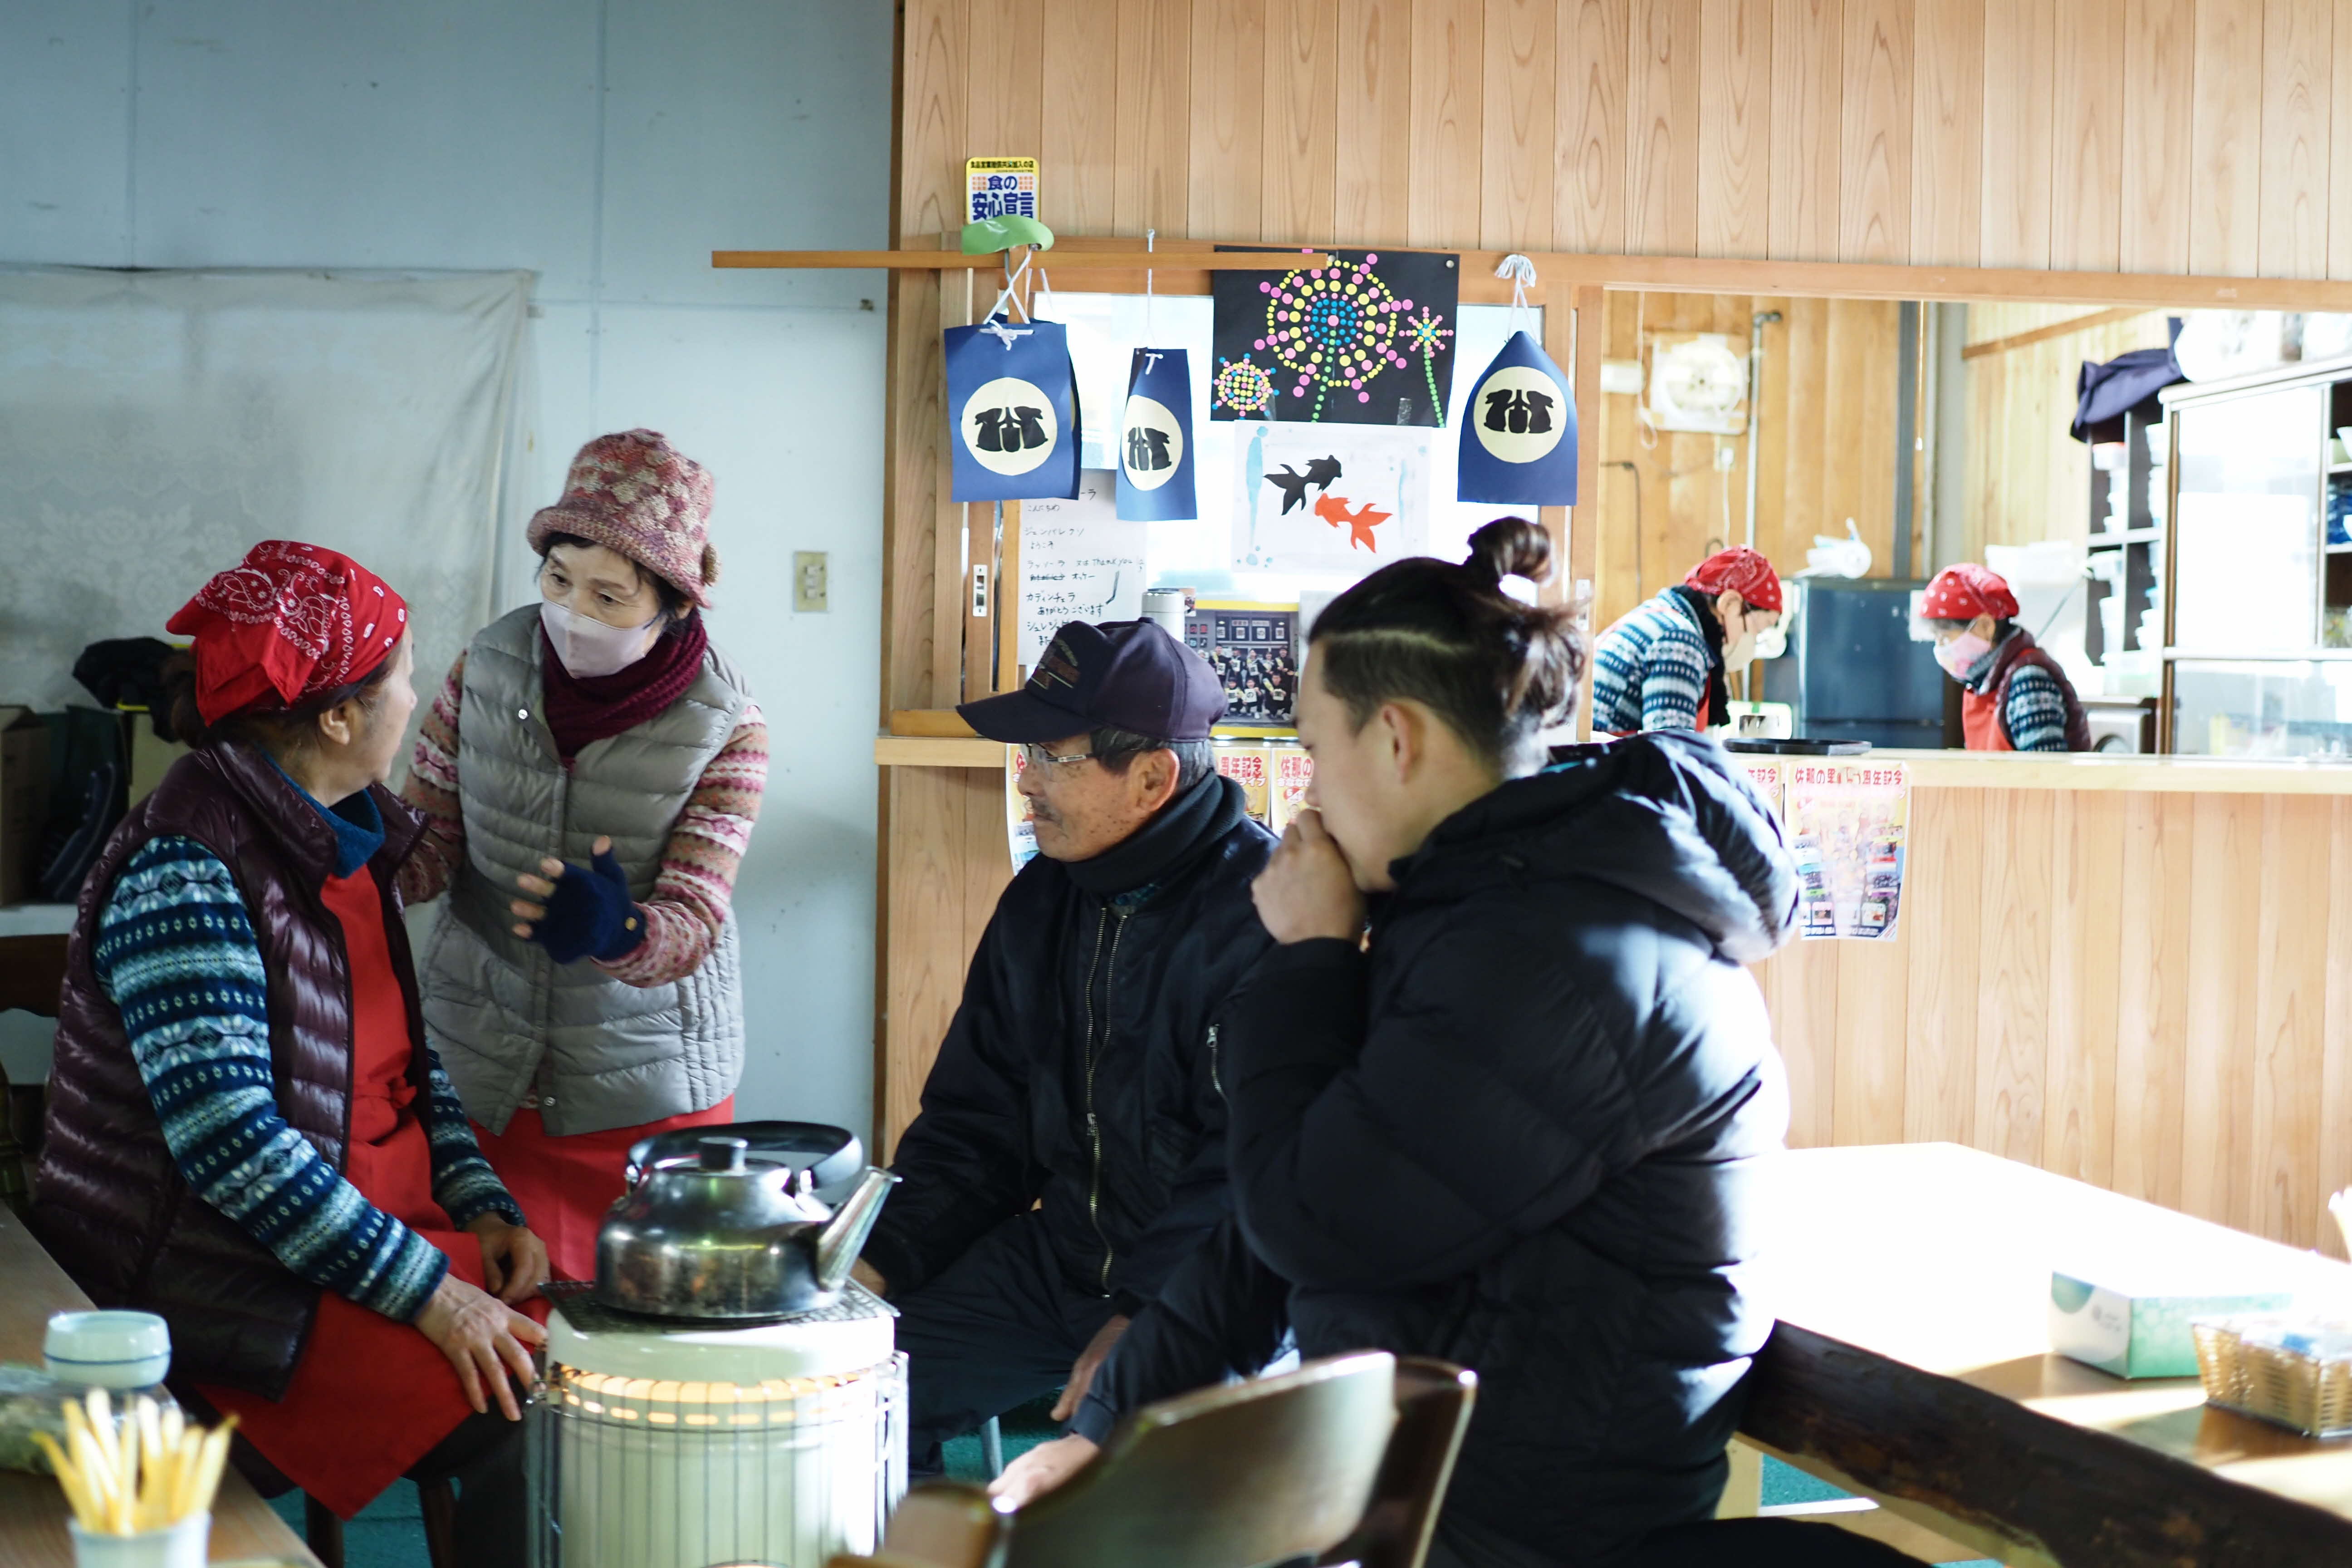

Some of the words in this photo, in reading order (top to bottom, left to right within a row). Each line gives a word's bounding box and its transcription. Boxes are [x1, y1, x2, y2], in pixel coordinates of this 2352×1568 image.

[988, 175, 1018, 191] 食の
[972, 191, 1034, 220] 安心宣言
[1037, 603, 1104, 617] ありがとうございます
[1232, 777, 1266, 787] ライフ
